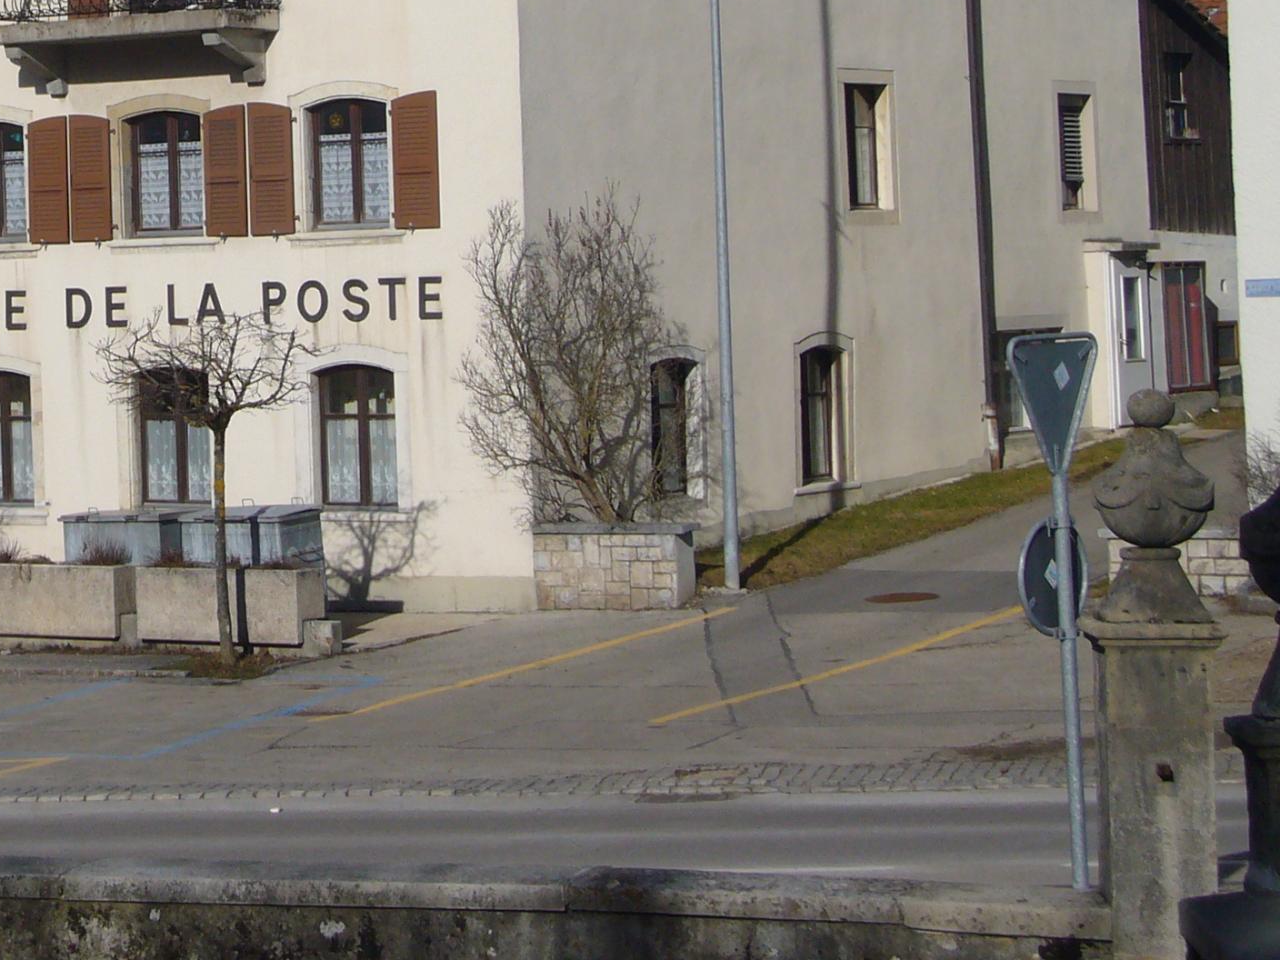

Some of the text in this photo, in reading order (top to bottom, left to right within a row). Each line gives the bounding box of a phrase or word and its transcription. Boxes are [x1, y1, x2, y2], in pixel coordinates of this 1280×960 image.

[65, 286, 128, 328] DE
[167, 283, 225, 326] LA
[261, 276, 443, 325] POSTE
